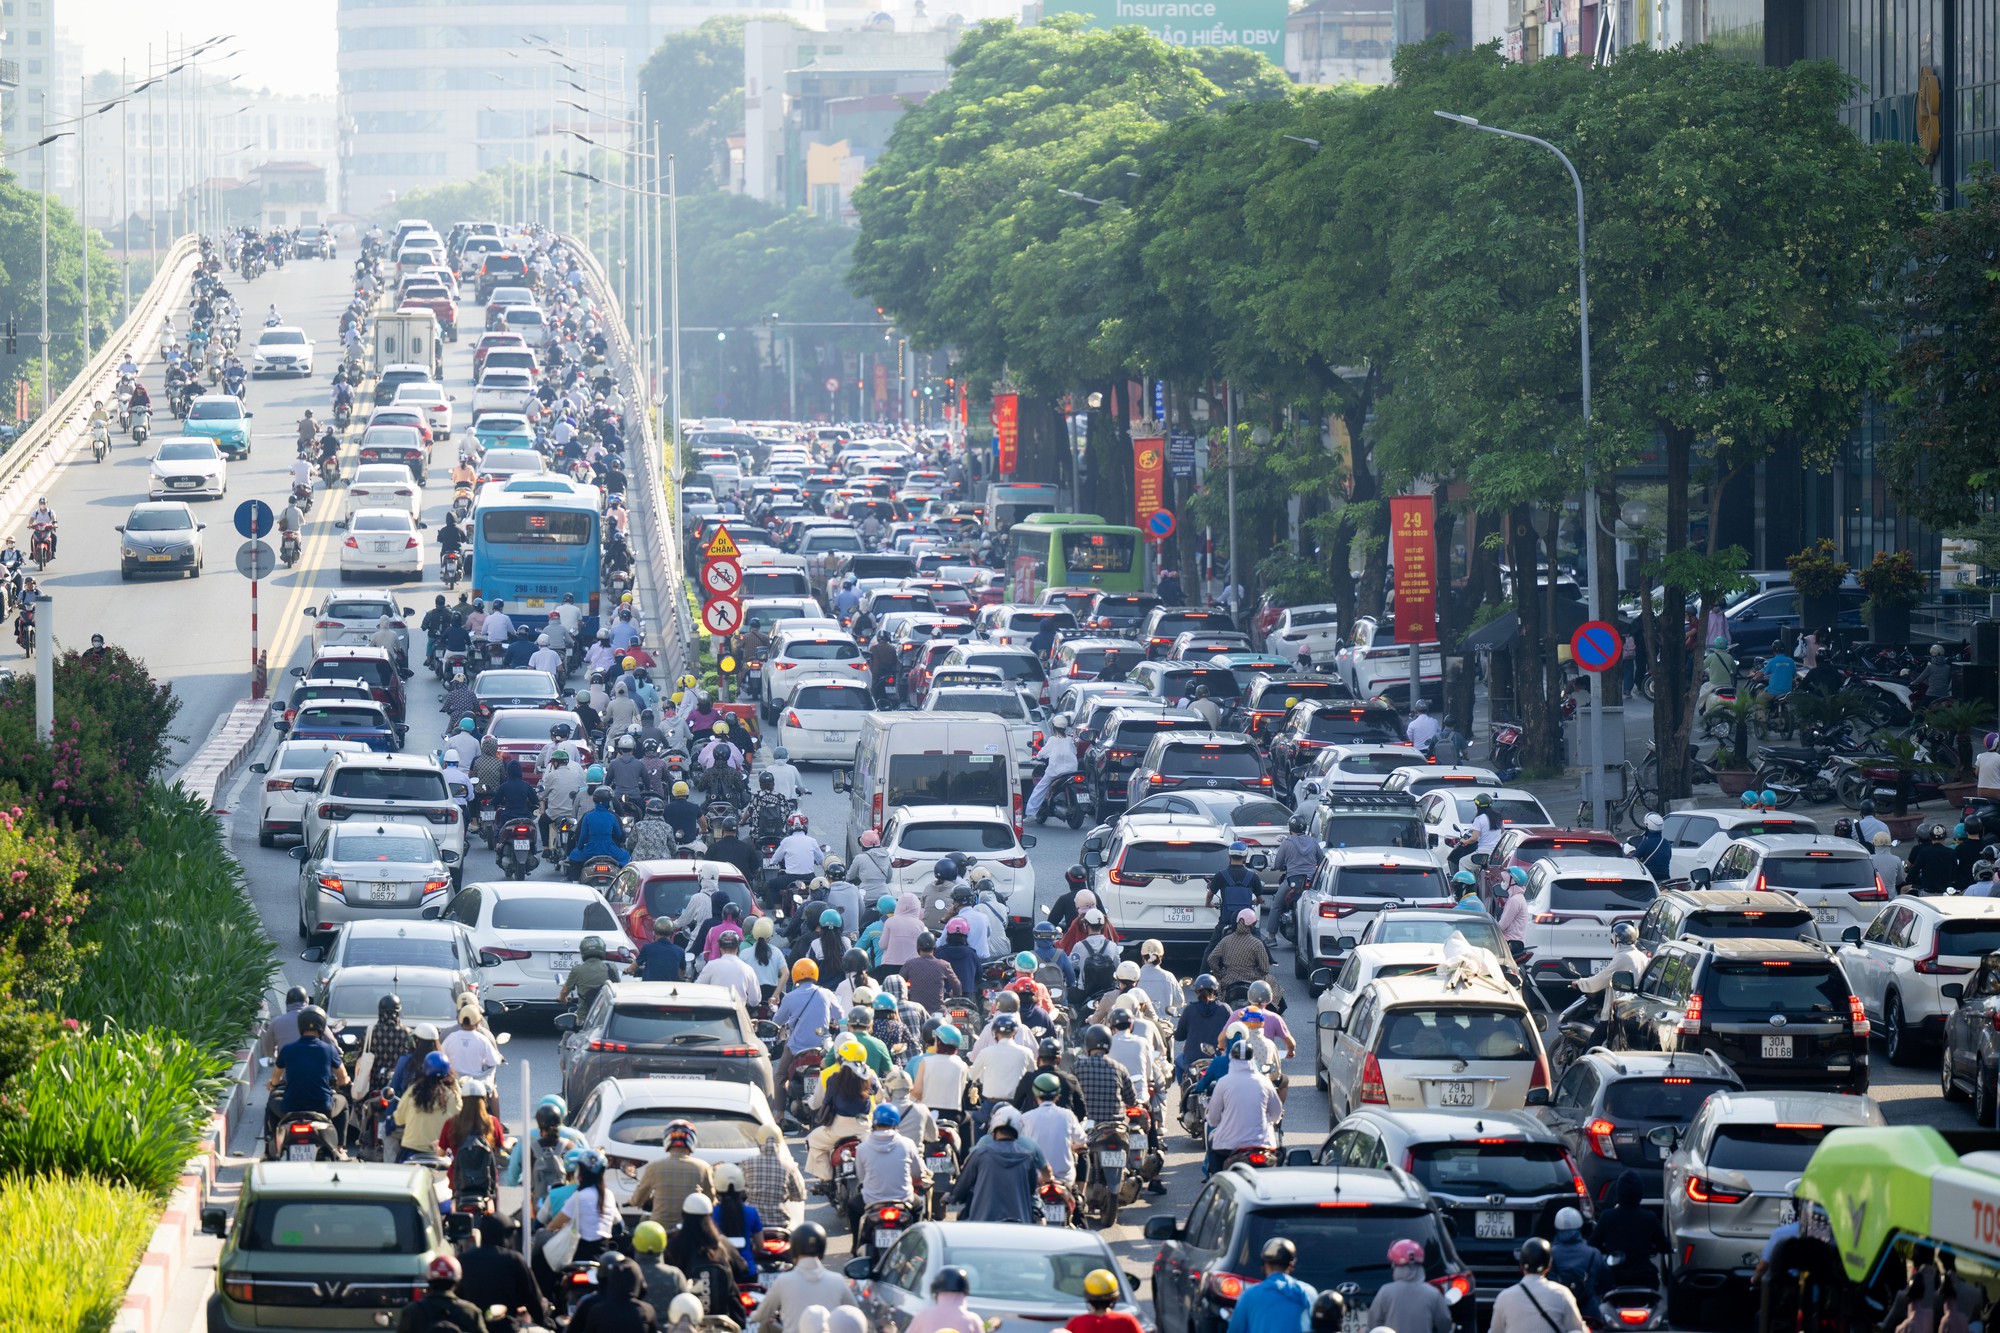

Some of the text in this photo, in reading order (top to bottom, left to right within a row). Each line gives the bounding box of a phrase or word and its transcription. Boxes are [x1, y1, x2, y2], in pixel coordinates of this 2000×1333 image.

[1116, 1, 1216, 17] Insurance
[1192, 22, 1237, 45] HIỂM
[1243, 30, 1280, 45] DBV
[376, 883, 390, 892] 28A
[371, 892, 395, 900] 085.72
[1768, 1037, 1784, 1046] 30A
[1762, 1047, 1791, 1057] 101.68
[1448, 1083, 1464, 1093] 29A
[1441, 1094, 1472, 1105] 414.22
[1484, 1212, 1503, 1223] 30E
[1475, 1225, 1511, 1236] 976.44
